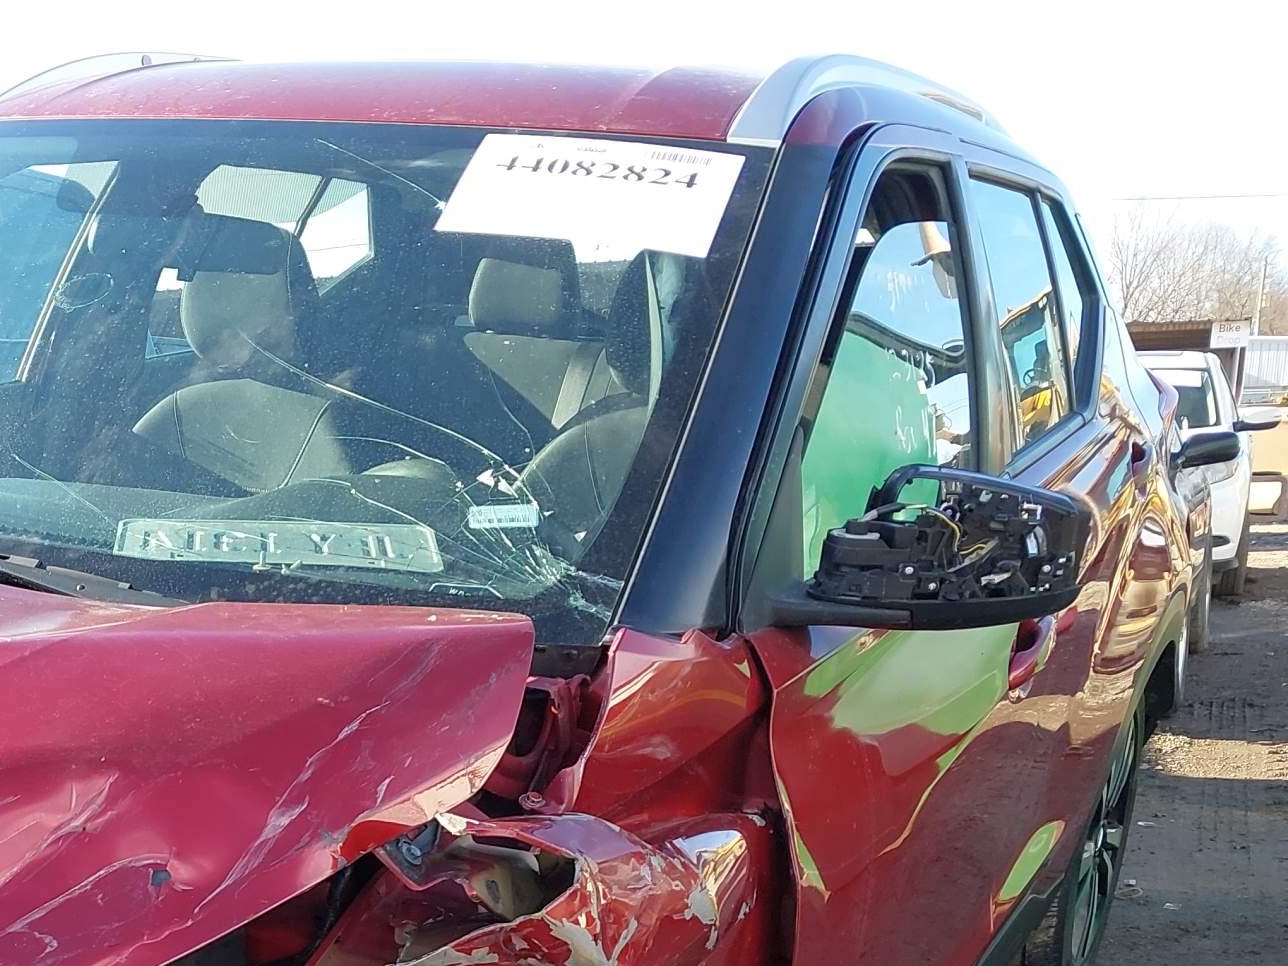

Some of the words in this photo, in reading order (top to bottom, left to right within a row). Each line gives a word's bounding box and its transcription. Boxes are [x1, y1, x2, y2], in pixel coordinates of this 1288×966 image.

[496, 155, 698, 188] 44082824
[1218, 323, 1240, 332] Bike
[1217, 336, 1240, 345] Drop
